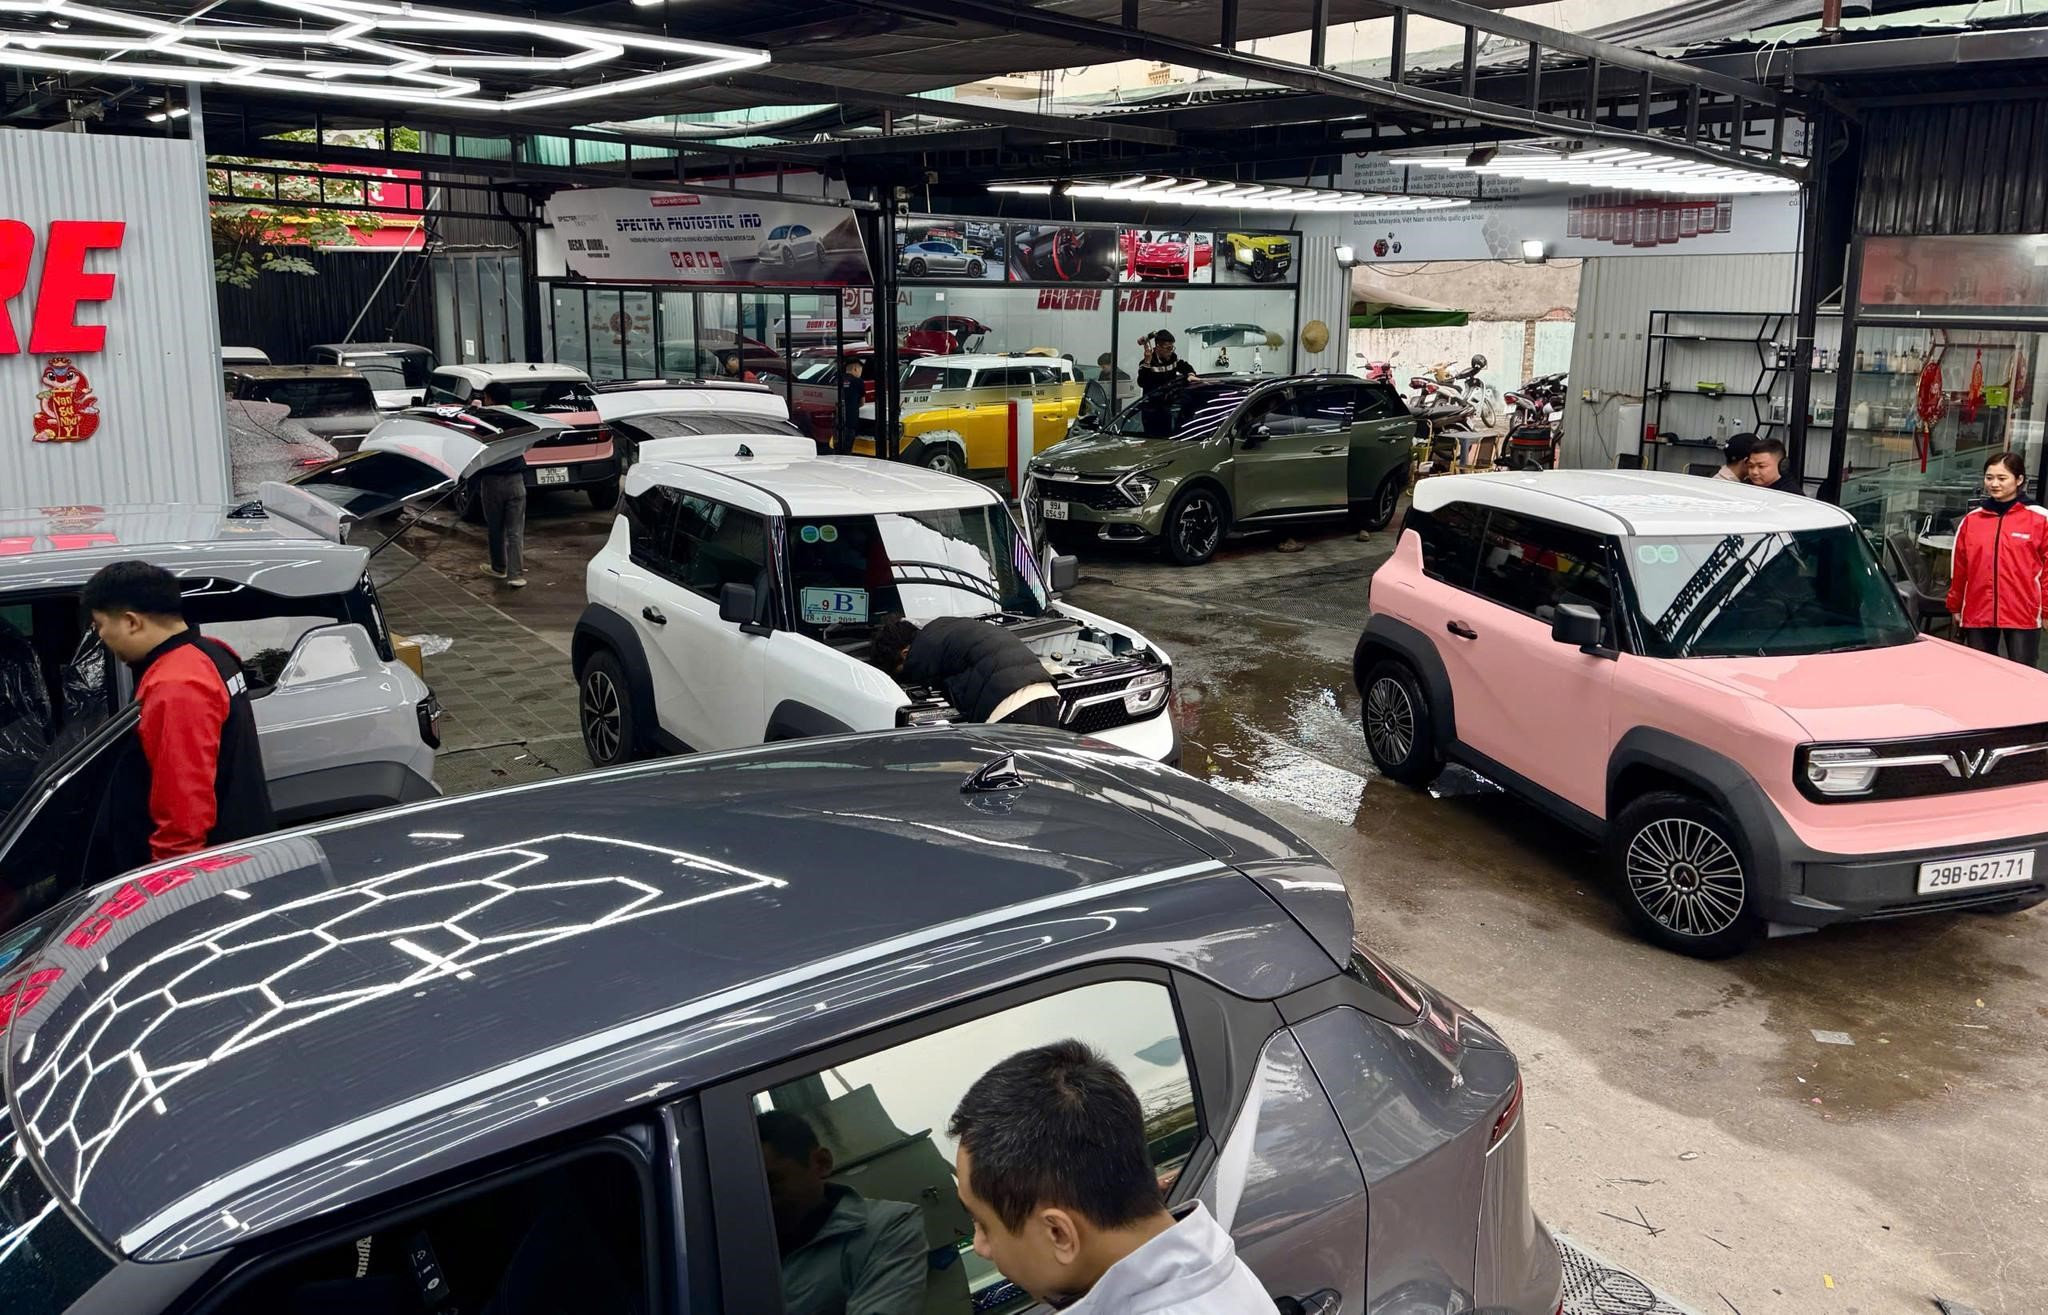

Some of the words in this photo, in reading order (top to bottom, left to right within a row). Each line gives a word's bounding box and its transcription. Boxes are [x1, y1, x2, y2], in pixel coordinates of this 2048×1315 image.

[616, 217, 665, 232] SPECTRA
[667, 214, 735, 231] PHOTOSYNC
[1037, 288, 1102, 310] DUBAI
[1119, 289, 1176, 312] CARE
[833, 593, 854, 612] B
[1929, 857, 2024, 888] 29B-627.71
